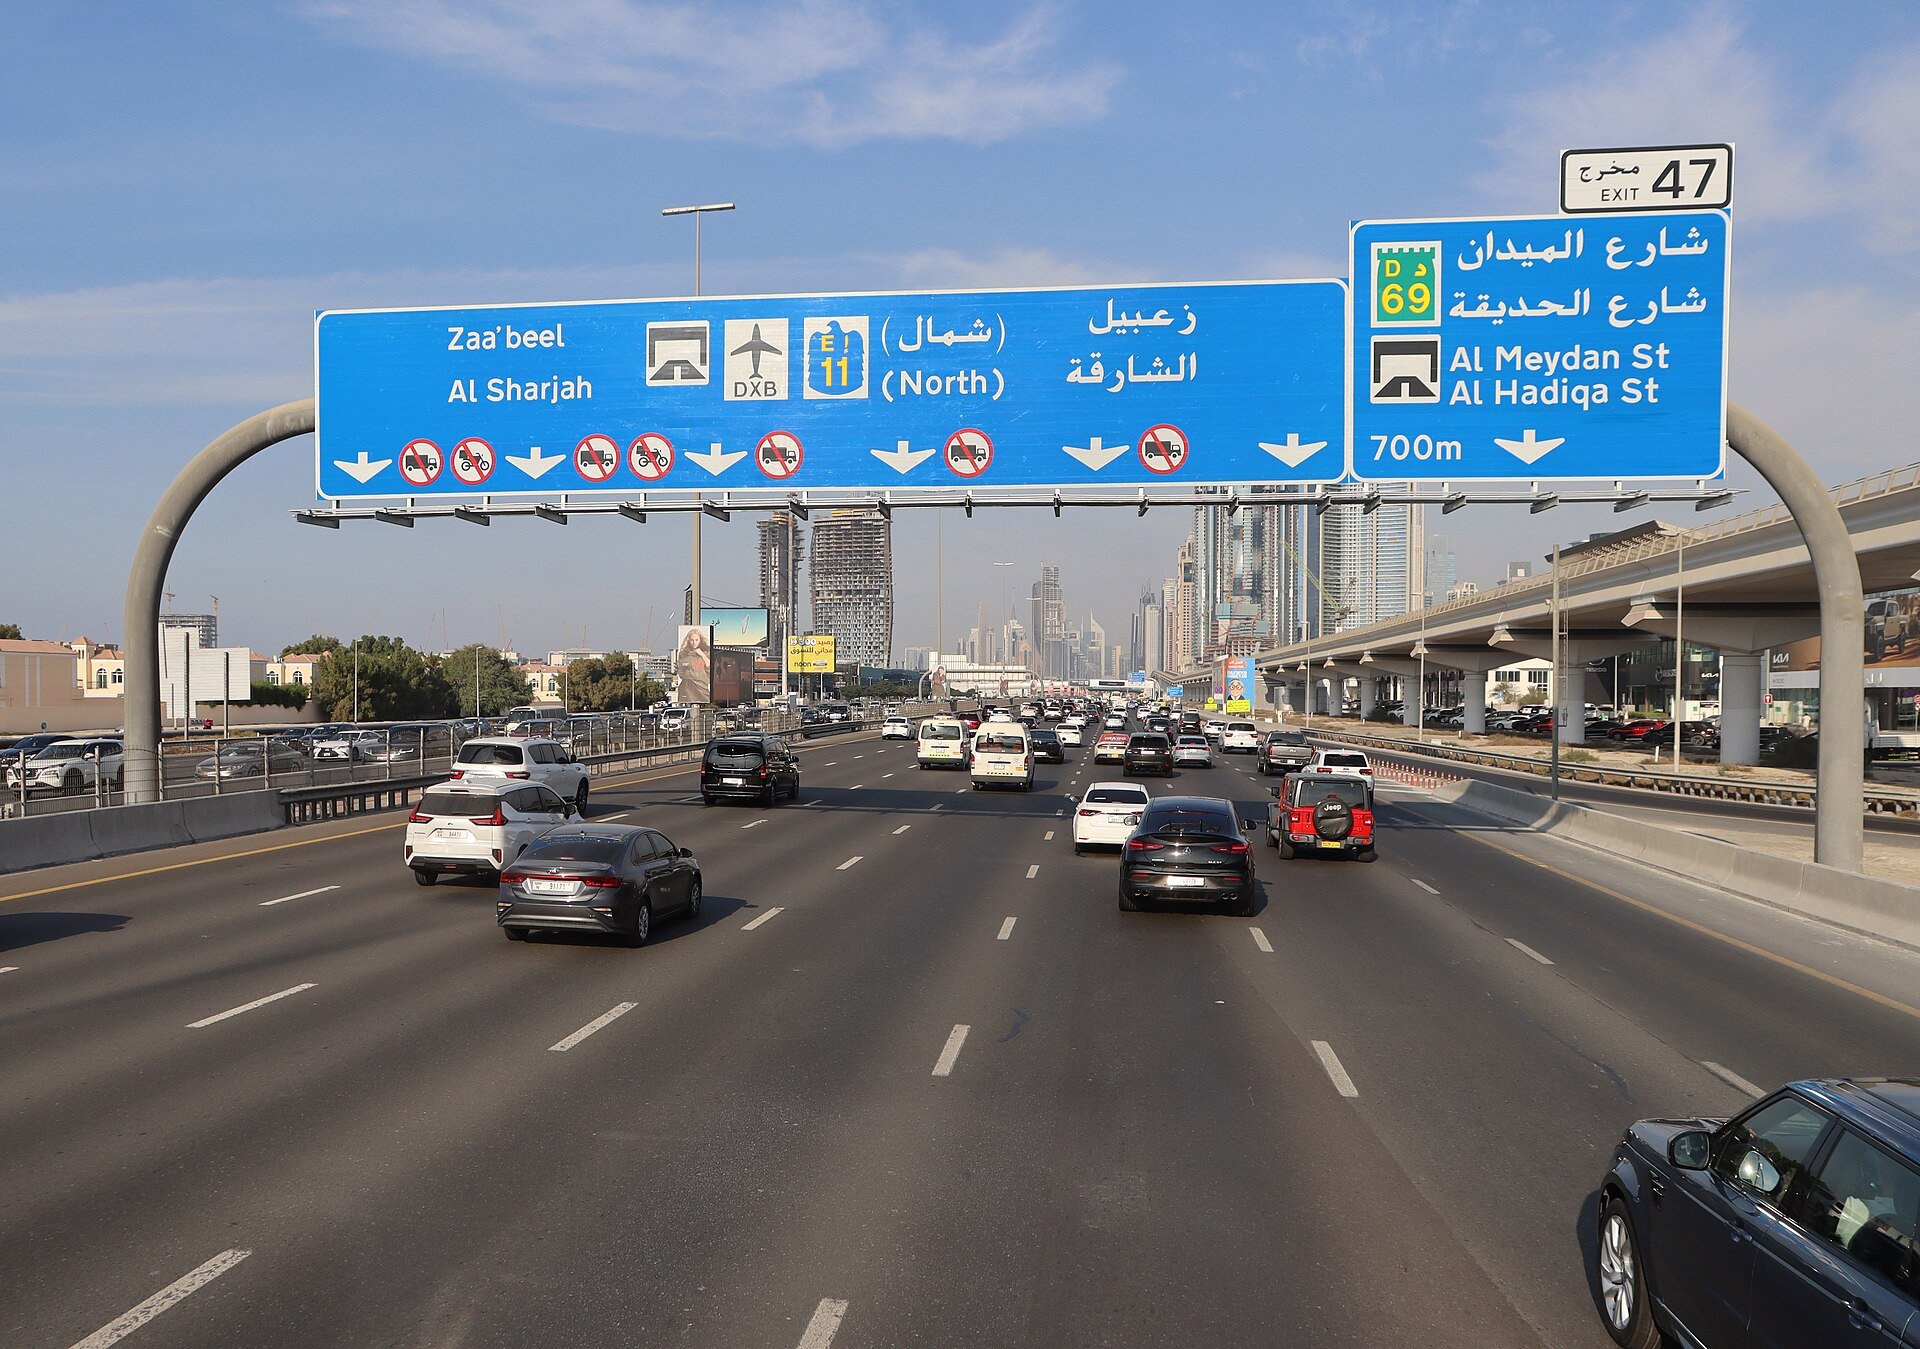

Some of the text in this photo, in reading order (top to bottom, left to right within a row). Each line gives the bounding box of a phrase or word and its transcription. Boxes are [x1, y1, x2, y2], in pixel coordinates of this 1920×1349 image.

[1579, 160, 1639, 182] مخرج
[1651, 159, 1717, 199] 47
[1601, 188, 1639, 202] EXIT
[1457, 226, 1708, 271] شارع الميدان
[1385, 260, 1400, 277] D
[1382, 284, 1430, 314] 69
[1449, 286, 1707, 328] شارع الحديقة
[1088, 298, 1197, 335] زعبيل
[821, 335, 835, 352] E
[821, 356, 848, 387] 11
[1066, 351, 1197, 393] الشارقة
[1449, 342, 1670, 377] Al Meydan St
[448, 374, 592, 404] Al Sharjah
[734, 381, 777, 398] DXB
[881, 368, 1005, 403] (North)
[1449, 376, 1659, 411] Al Hadiqa St
[1370, 434, 1462, 461] 700m
